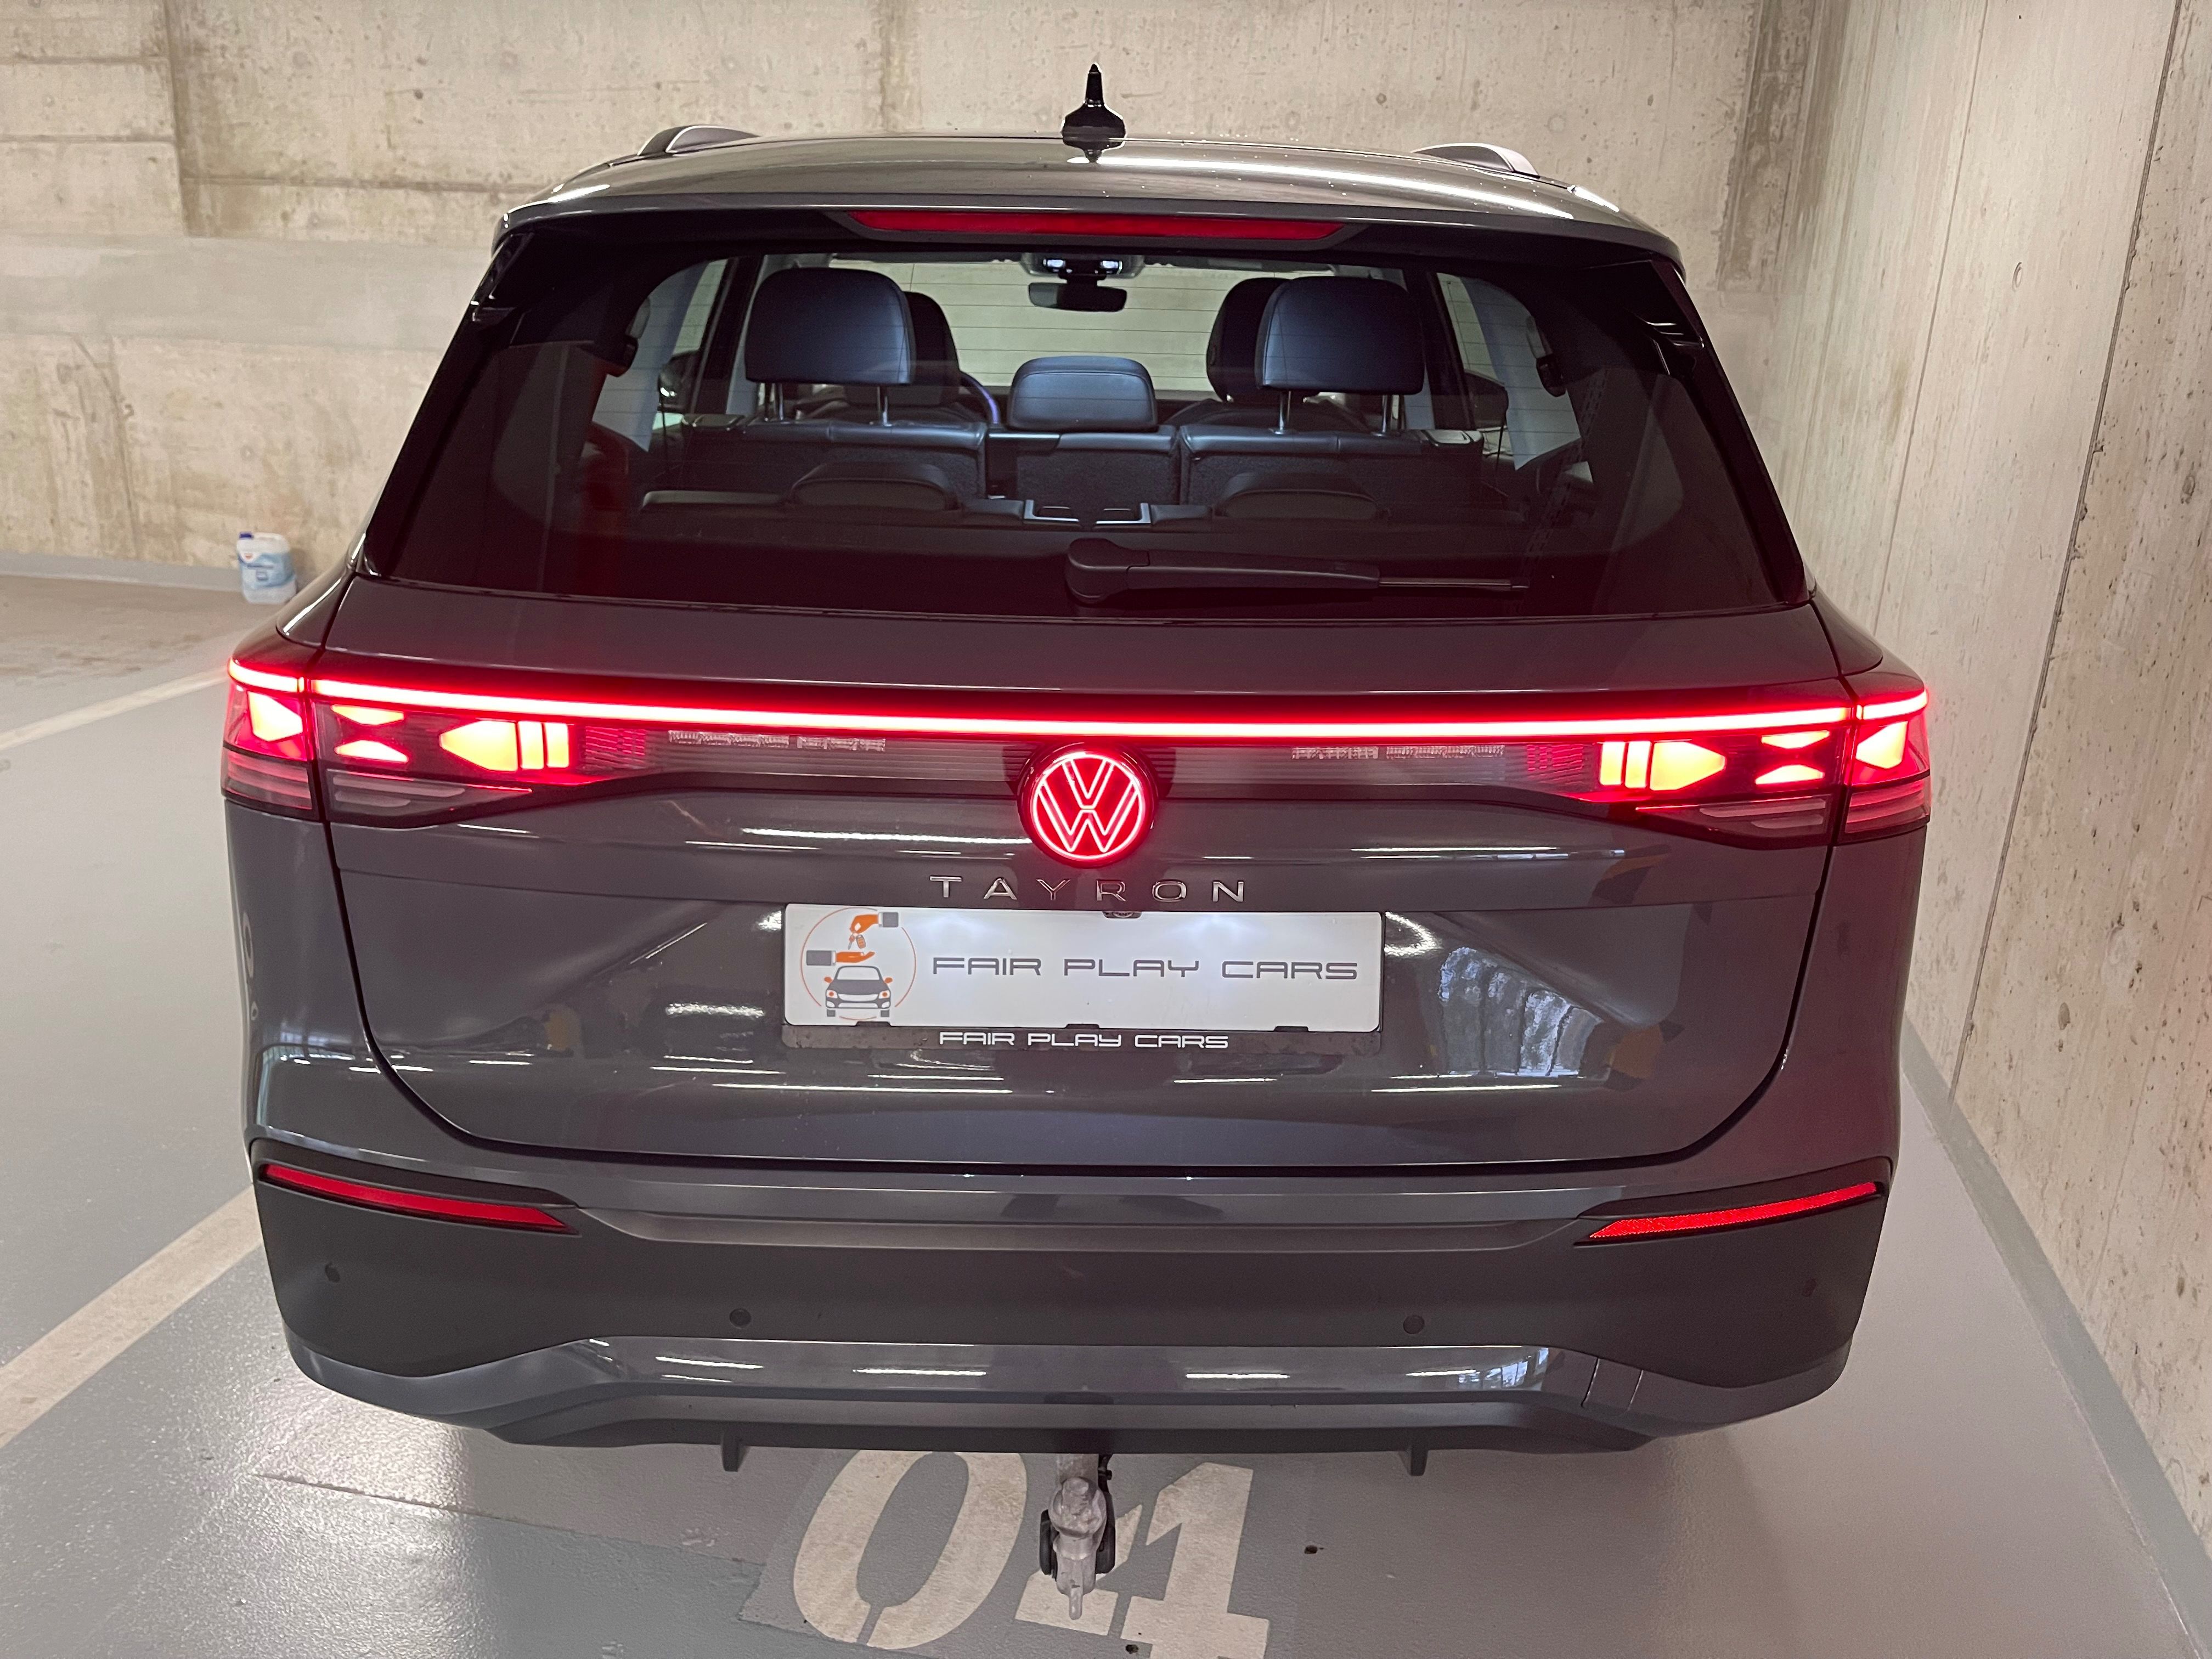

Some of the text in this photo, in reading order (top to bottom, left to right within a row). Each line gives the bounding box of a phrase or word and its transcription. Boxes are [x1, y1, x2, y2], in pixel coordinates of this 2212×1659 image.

[1036, 757, 1139, 854] VW
[930, 876, 1244, 902] TAYRON
[933, 957, 1357, 980] FAIR PLAY CARS
[939, 1031, 1229, 1049] FAIR PLAY CARS
